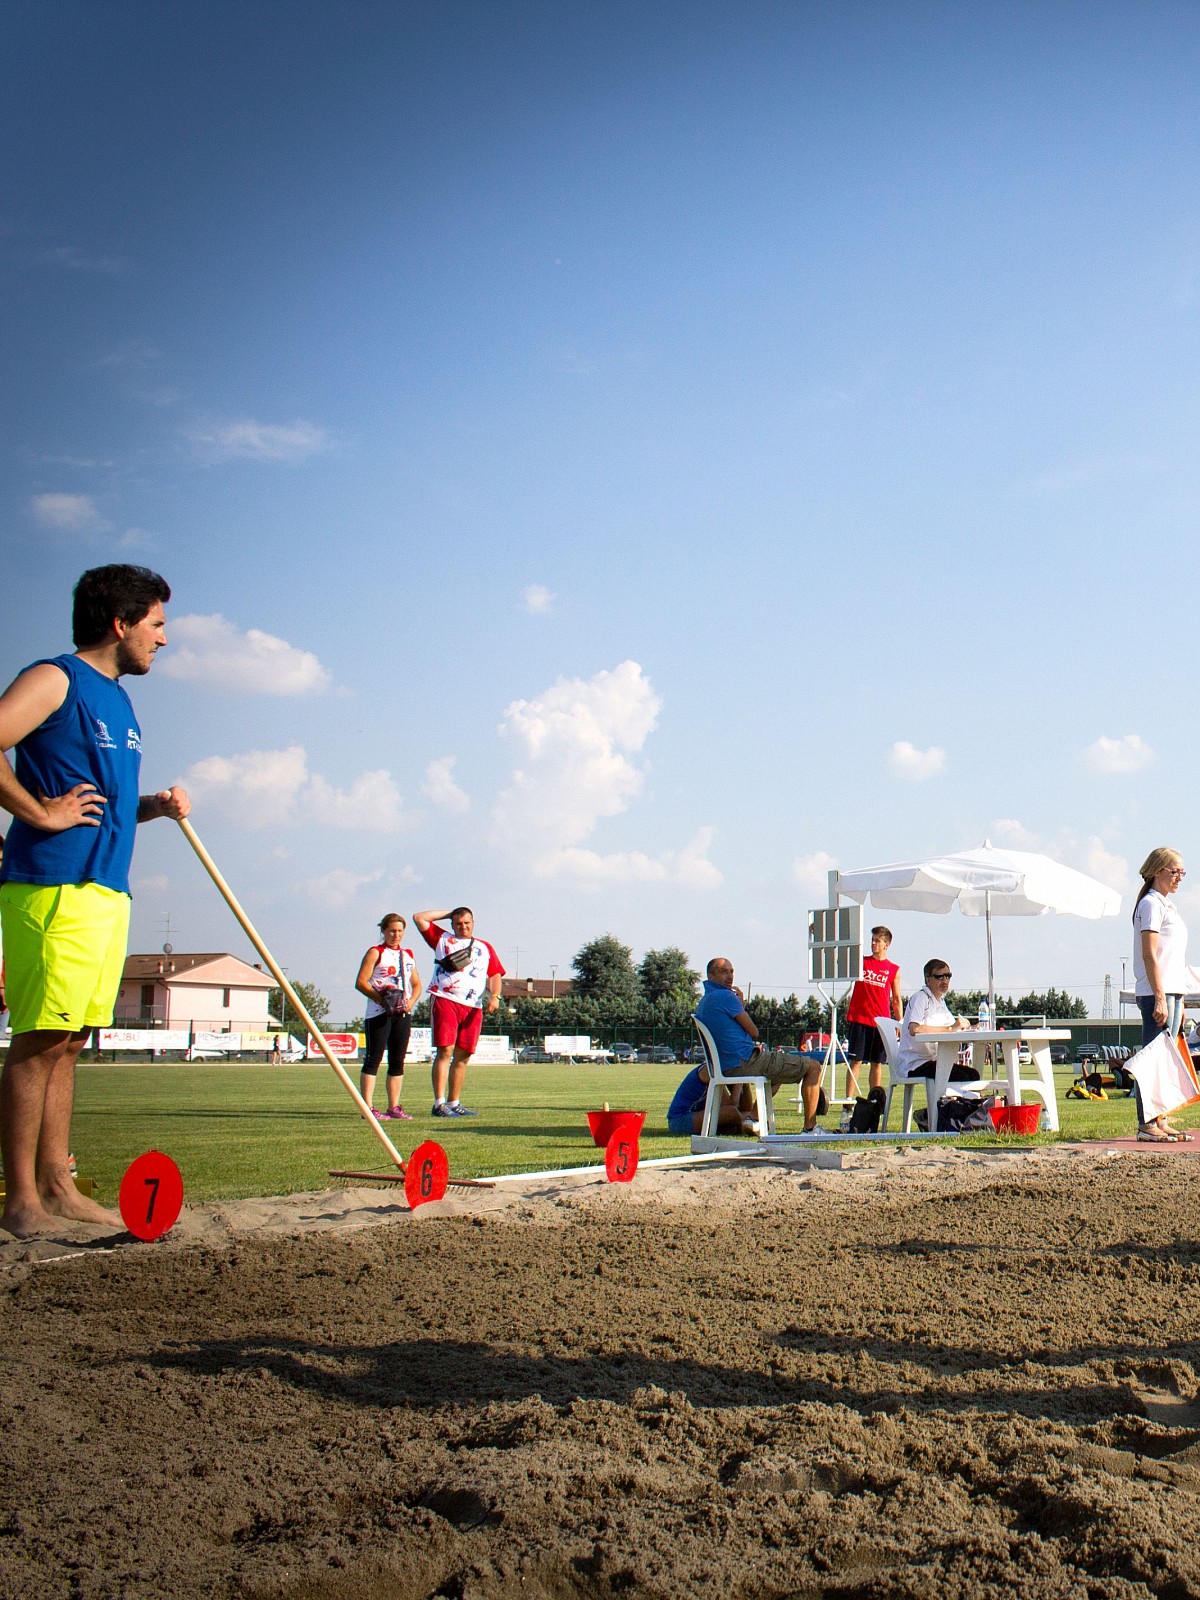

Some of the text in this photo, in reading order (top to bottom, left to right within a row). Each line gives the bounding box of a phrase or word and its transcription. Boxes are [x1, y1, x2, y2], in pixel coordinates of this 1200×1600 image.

[616, 1142, 629, 1175] 5
[421, 1159, 433, 1197] 6
[144, 1178, 160, 1223] 7
